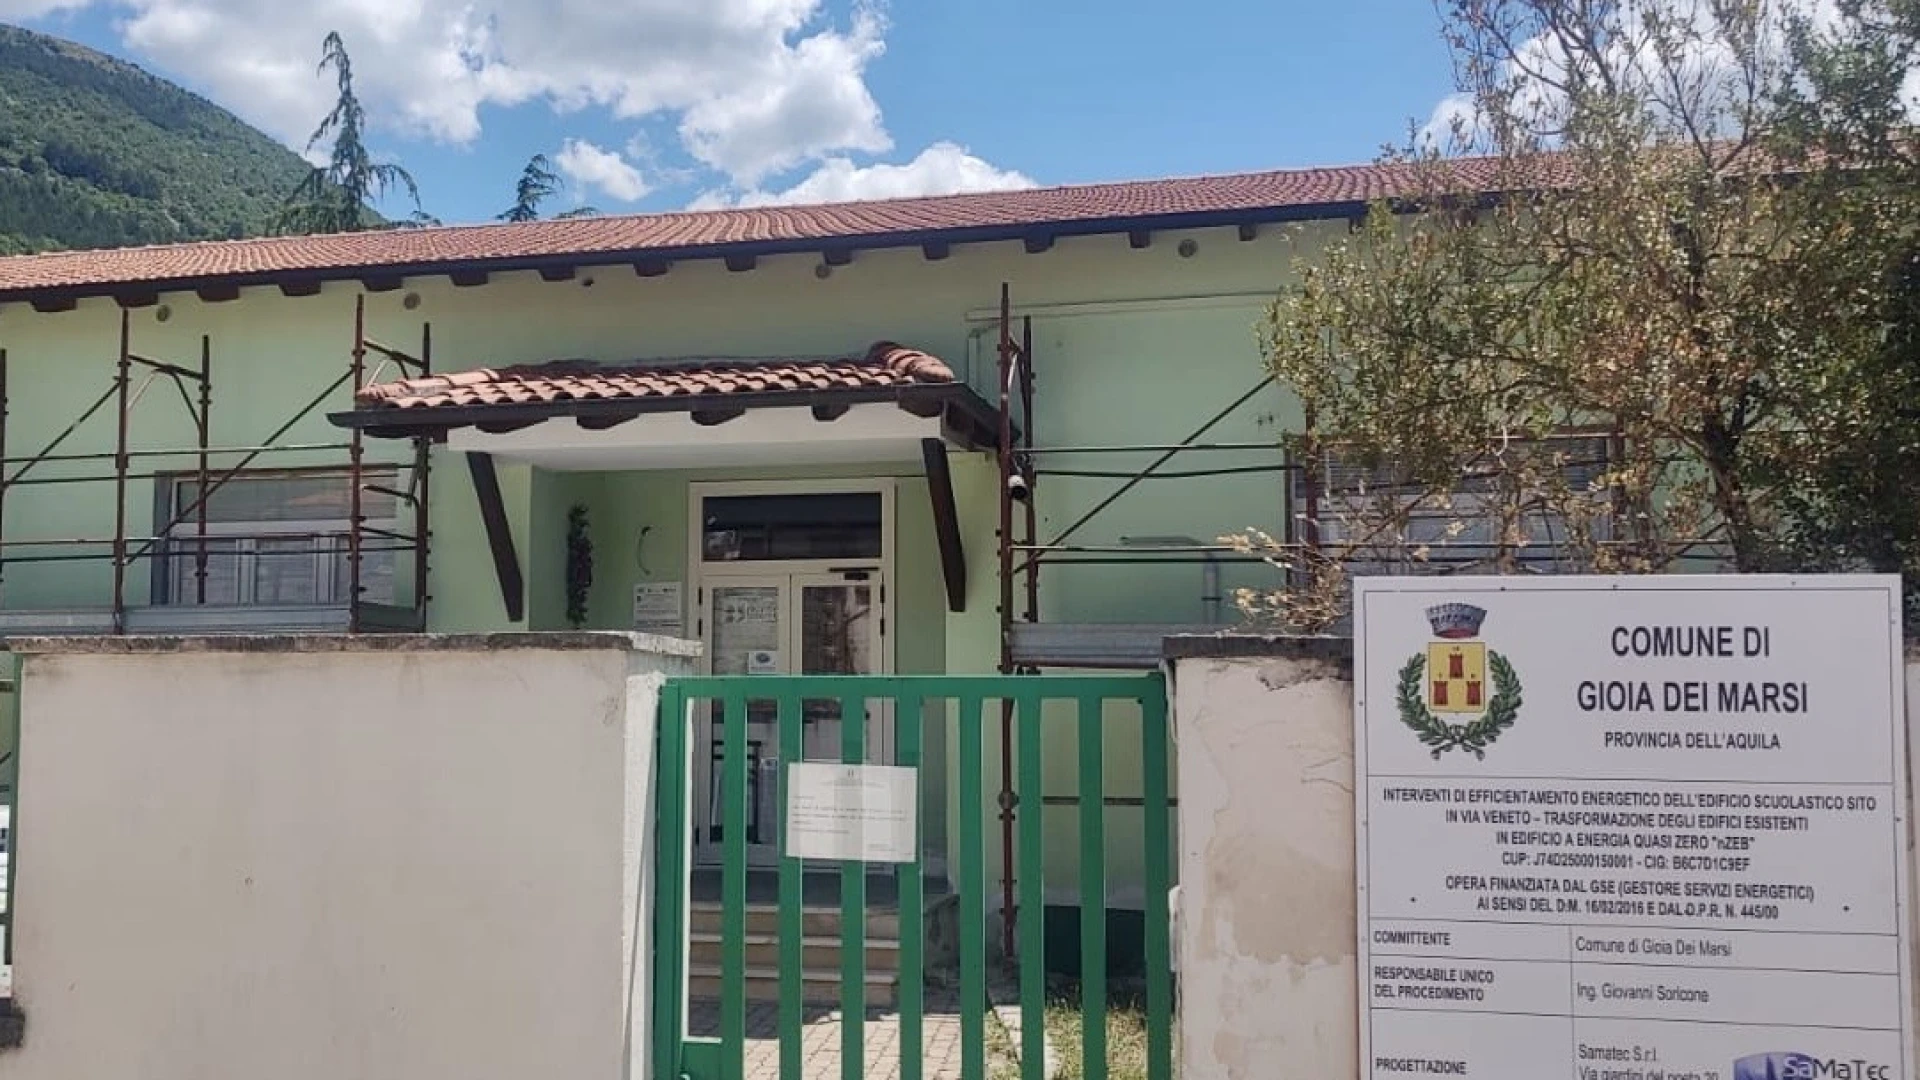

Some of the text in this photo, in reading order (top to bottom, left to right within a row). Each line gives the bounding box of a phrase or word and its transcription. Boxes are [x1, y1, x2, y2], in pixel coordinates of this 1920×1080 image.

[1612, 626, 1770, 657] COMUNE DI
[1578, 681, 1808, 713] GIOIA DEI MARSI
[1605, 732, 1781, 750] PROVINCIA DELL'AQUILA
[1383, 788, 1877, 811] INTERVENTI DI EFFICIENTAMENTO ENERGETICO DELL'EDIFICIO SCUOLASTICO SITO
[1446, 810, 1458, 822] IN
[1460, 810, 1481, 823] VIA
[1483, 810, 1531, 824] VENETO
[1544, 811, 1655, 828] TRASFORMAZIONE
[1658, 813, 1695, 828] DEGLI
[1698, 814, 1741, 829] EDIFICI
[1745, 815, 1808, 831] ESISTENTI
[1496, 832, 1508, 845] IN
[1511, 832, 1562, 846] EDIFICIO
[1565, 833, 1573, 846] A
[1577, 833, 1630, 847] ENERGIA
[1634, 834, 1672, 849] QUASI
[1675, 835, 1709, 850] ZERO
[1502, 852, 1530, 866] CUP:
[1644, 854, 1669, 870] CIG:
[1445, 876, 1814, 903] OPERA FINANZIATA DAL GSE (GESTORE SERVIZI ENERGETICI)
[1477, 897, 1489, 910] AI
[1492, 897, 1527, 911] SENSI
[1529, 897, 1553, 912] DEL
[1647, 901, 1656, 915] E
[1659, 902, 1682, 916] DAL
[1725, 903, 1738, 918] N.
[1373, 930, 1451, 946] COMMITTENTE
[1575, 935, 1732, 956] Comune di Gioia Dei Marsi
[1374, 965, 1495, 984] RESPONSABILE UNICO
[1374, 984, 1485, 1002] DEL PROCEDIMENTO
[1577, 982, 1597, 1002] Ing.
[1602, 982, 1653, 1000] Giovanni
[1578, 1044, 1630, 1061] Samatec
[1375, 1057, 1467, 1075] PROGETTAZIONE
[1579, 1066, 1597, 1080] Via
